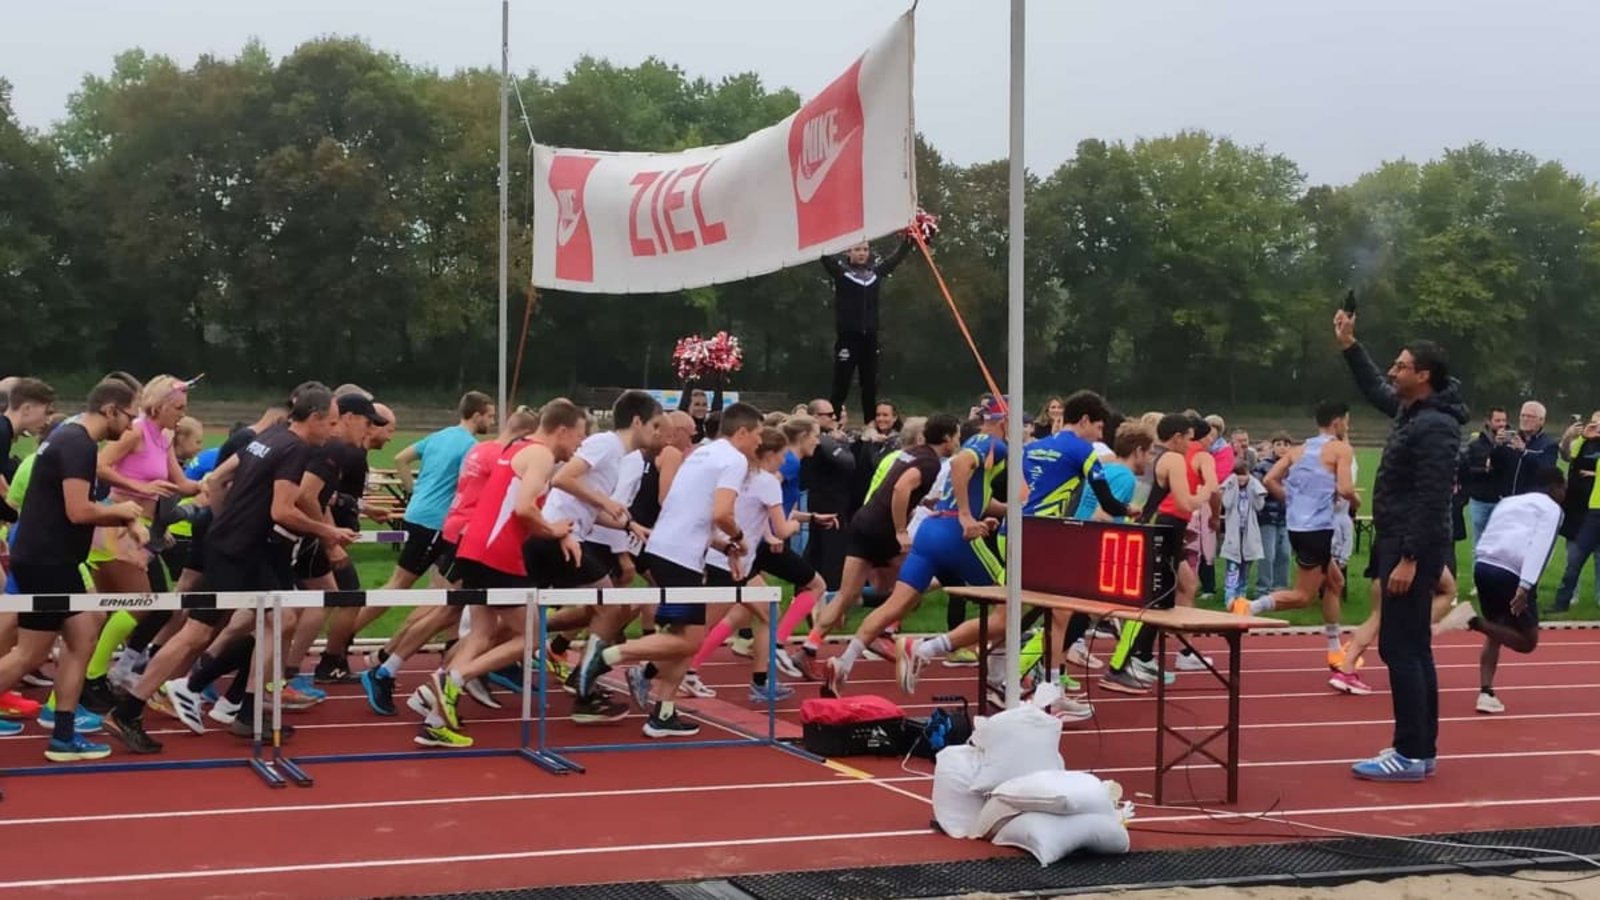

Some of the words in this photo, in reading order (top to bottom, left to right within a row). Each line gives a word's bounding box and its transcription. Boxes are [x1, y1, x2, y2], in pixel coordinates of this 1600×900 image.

[802, 108, 838, 168] NIKE
[629, 157, 727, 256] ZIEL
[1099, 531, 1144, 596] 00
